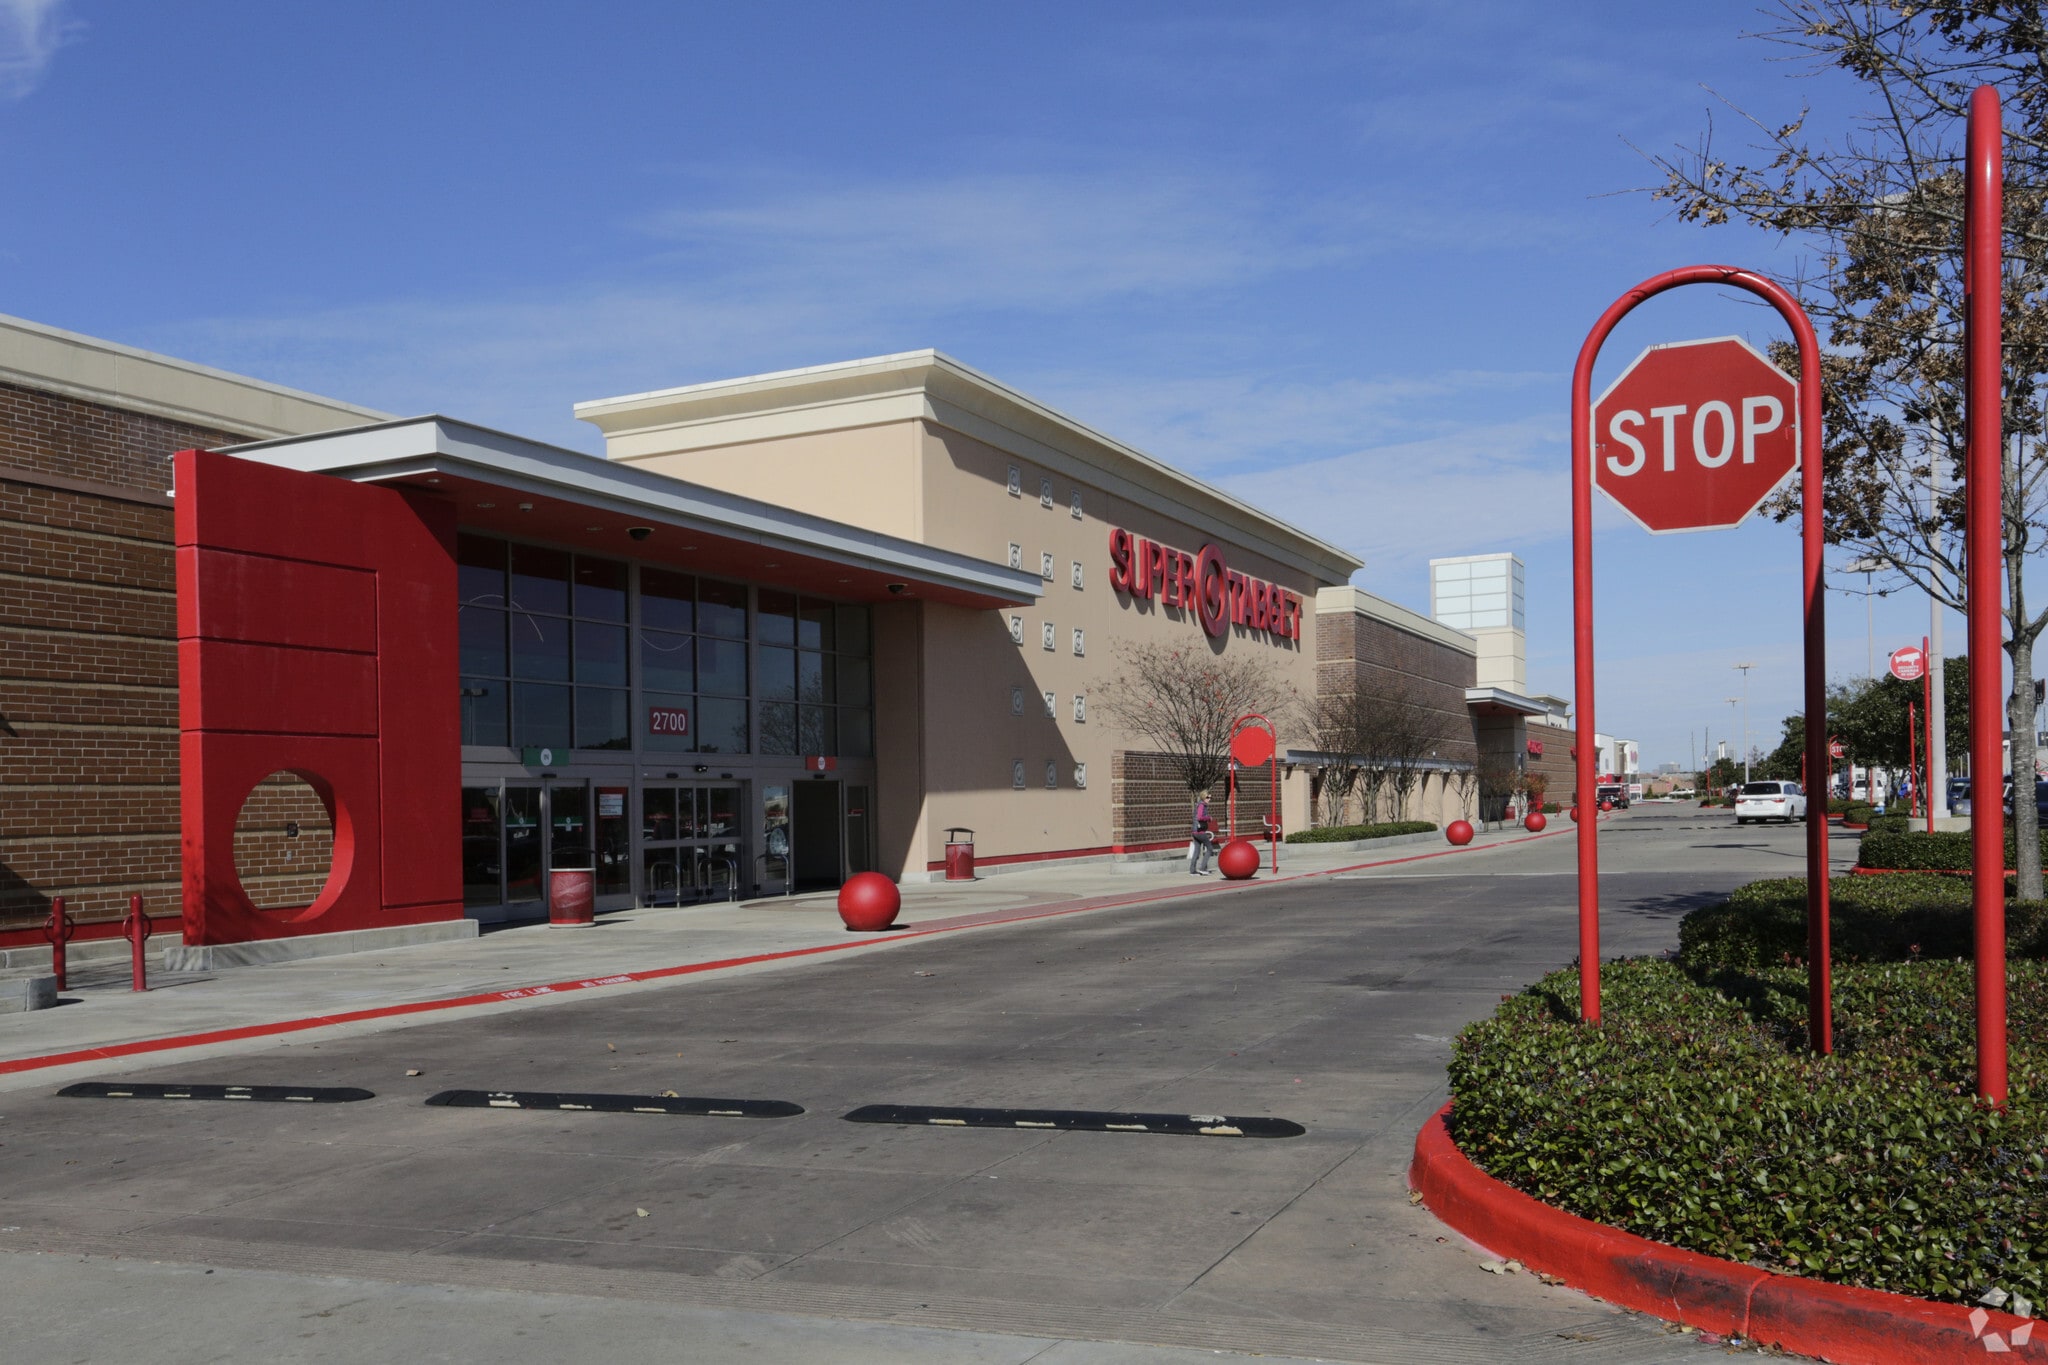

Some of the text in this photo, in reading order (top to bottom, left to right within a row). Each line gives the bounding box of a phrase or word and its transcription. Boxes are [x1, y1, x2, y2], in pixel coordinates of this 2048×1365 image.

[1606, 395, 1784, 477] STOP
[1109, 528, 1303, 641] SUPER TARGET
[653, 711, 686, 732] 2700
[501, 986, 555, 999] FIRE LANE
[579, 980, 596, 988] NO
